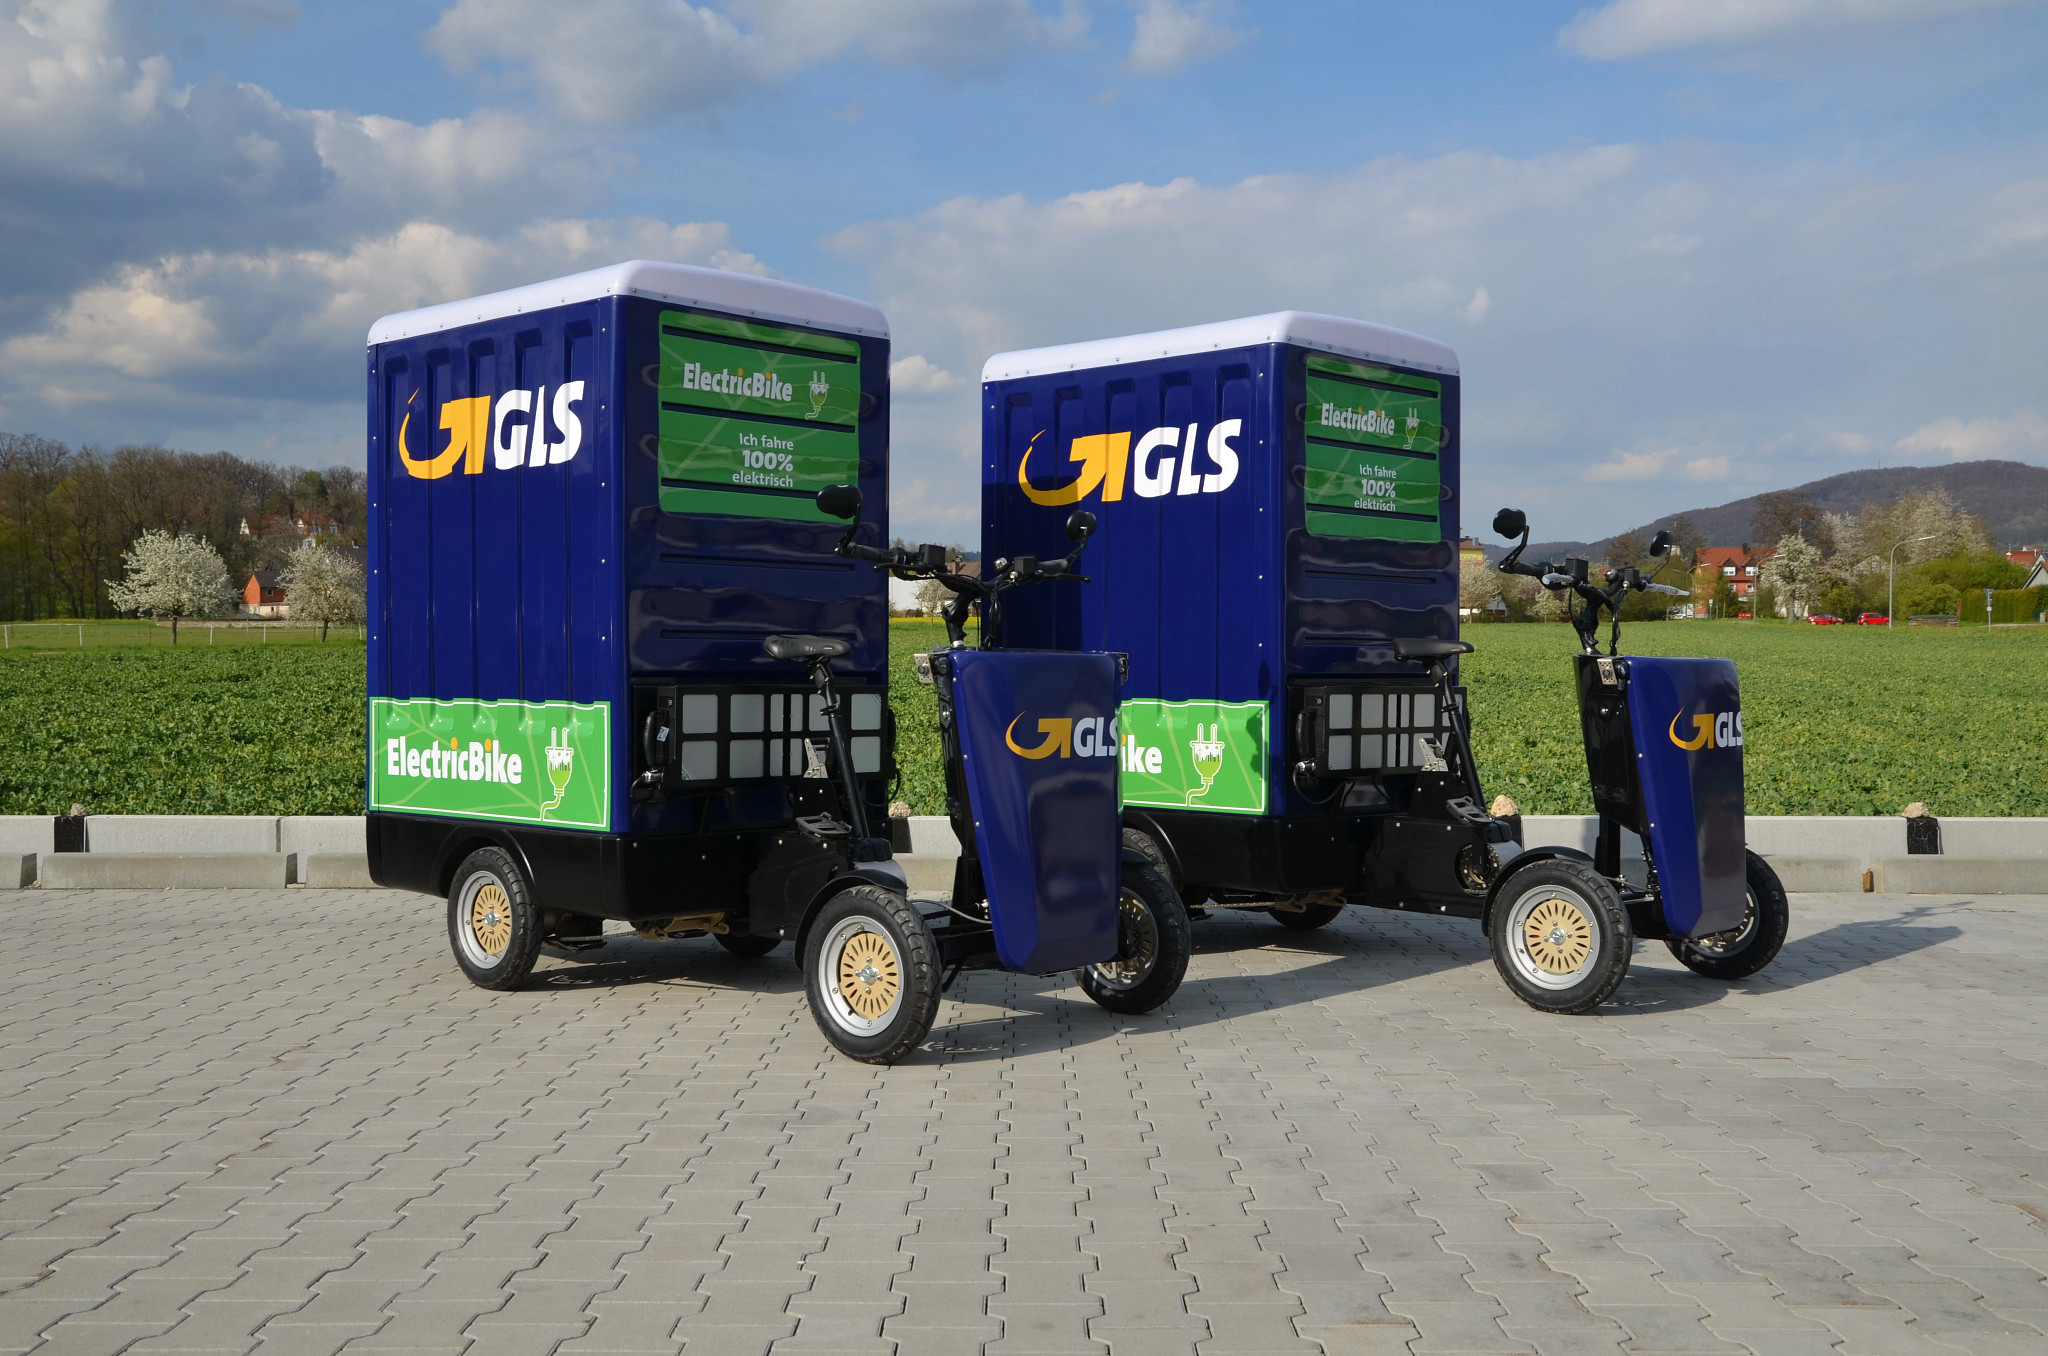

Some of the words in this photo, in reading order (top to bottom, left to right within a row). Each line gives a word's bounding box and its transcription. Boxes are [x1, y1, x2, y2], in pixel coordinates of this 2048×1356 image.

[683, 362, 793, 402] ElectricBike
[493, 380, 585, 471] GLS
[1321, 402, 1395, 435] ElectricBike
[739, 432, 758, 447] Ich
[760, 434, 794, 451] fahre
[742, 450, 794, 472] 100%
[1133, 418, 1242, 498] GLS
[732, 469, 794, 488] elektrisch
[1359, 464, 1373, 476] Ich
[1374, 465, 1397, 479] fahre
[1361, 479, 1396, 498] 100%
[1354, 497, 1396, 513] elektrisch
[387, 735, 523, 785] ElectricBike
